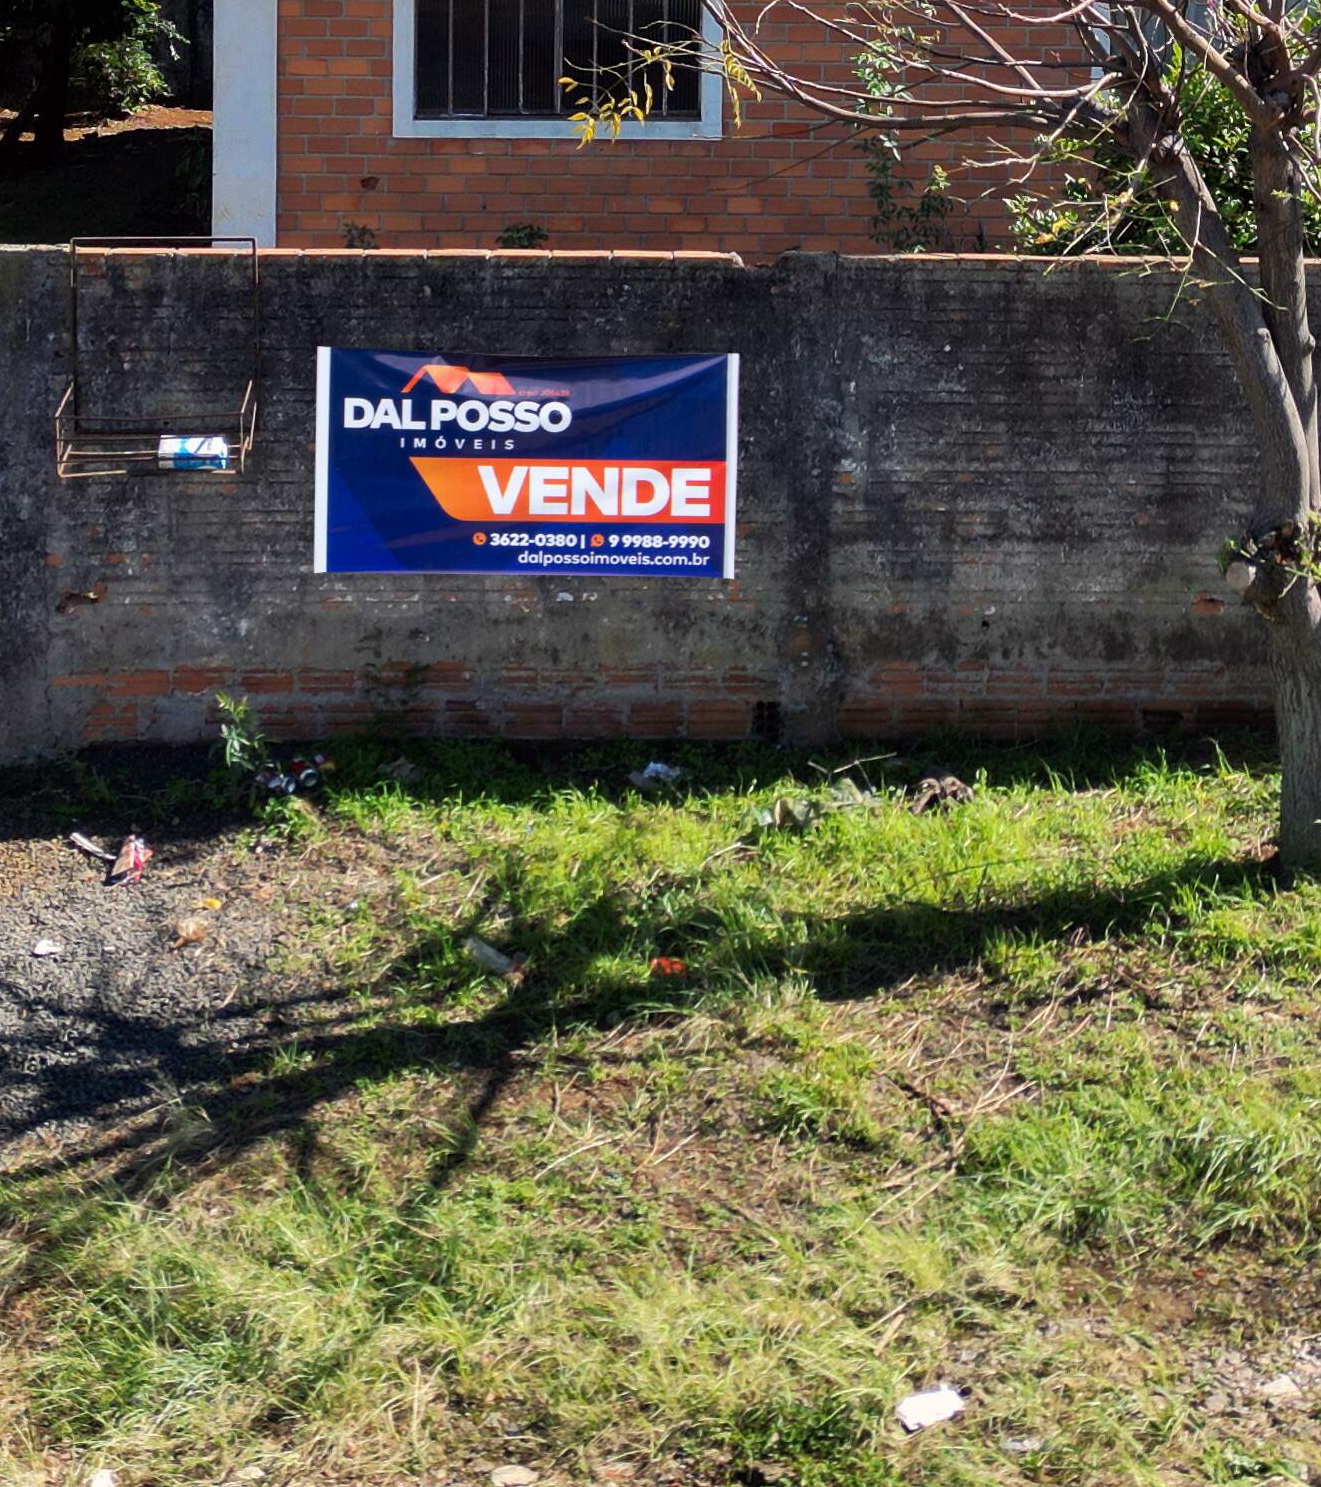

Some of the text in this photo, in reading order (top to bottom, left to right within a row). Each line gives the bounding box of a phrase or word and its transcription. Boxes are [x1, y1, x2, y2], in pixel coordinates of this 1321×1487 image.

[343, 397, 572, 433] DAL POSSO
[400, 436, 515, 450] IMÓVEIS
[478, 465, 712, 517] VENDE
[489, 532, 578, 548] 3622-0380
[608, 534, 621, 548] 9
[621, 534, 711, 549] 9988-9990
[517, 550, 711, 567] dalpossoimoveis.com.br
